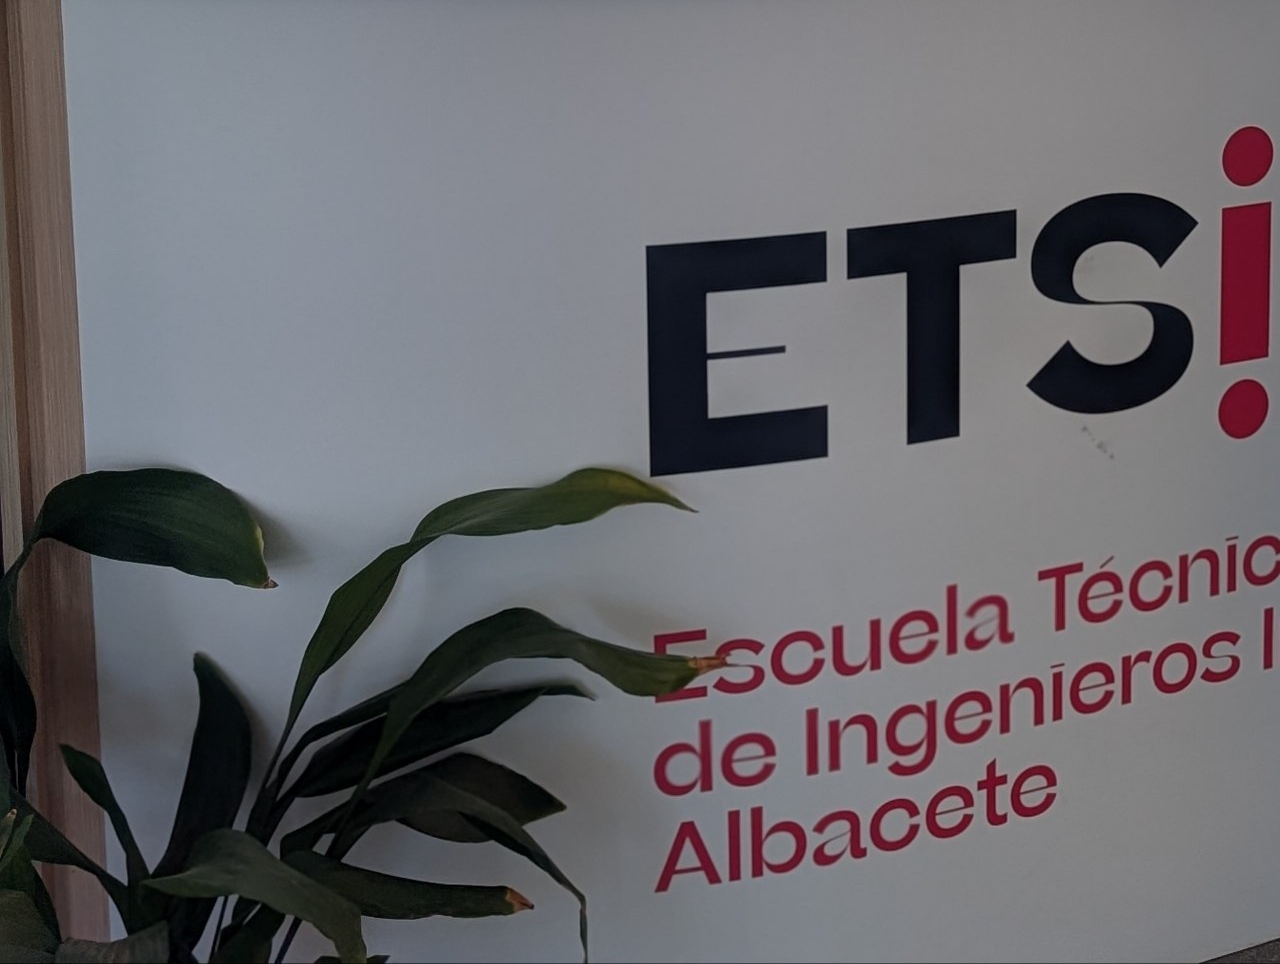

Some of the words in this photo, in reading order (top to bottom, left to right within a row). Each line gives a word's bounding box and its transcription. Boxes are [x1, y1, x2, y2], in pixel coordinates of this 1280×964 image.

[653, 584, 1015, 703] Escuela
[653, 719, 777, 797] de
[805, 629, 1241, 777] Ingenieros
[654, 757, 1059, 894] Albacete
